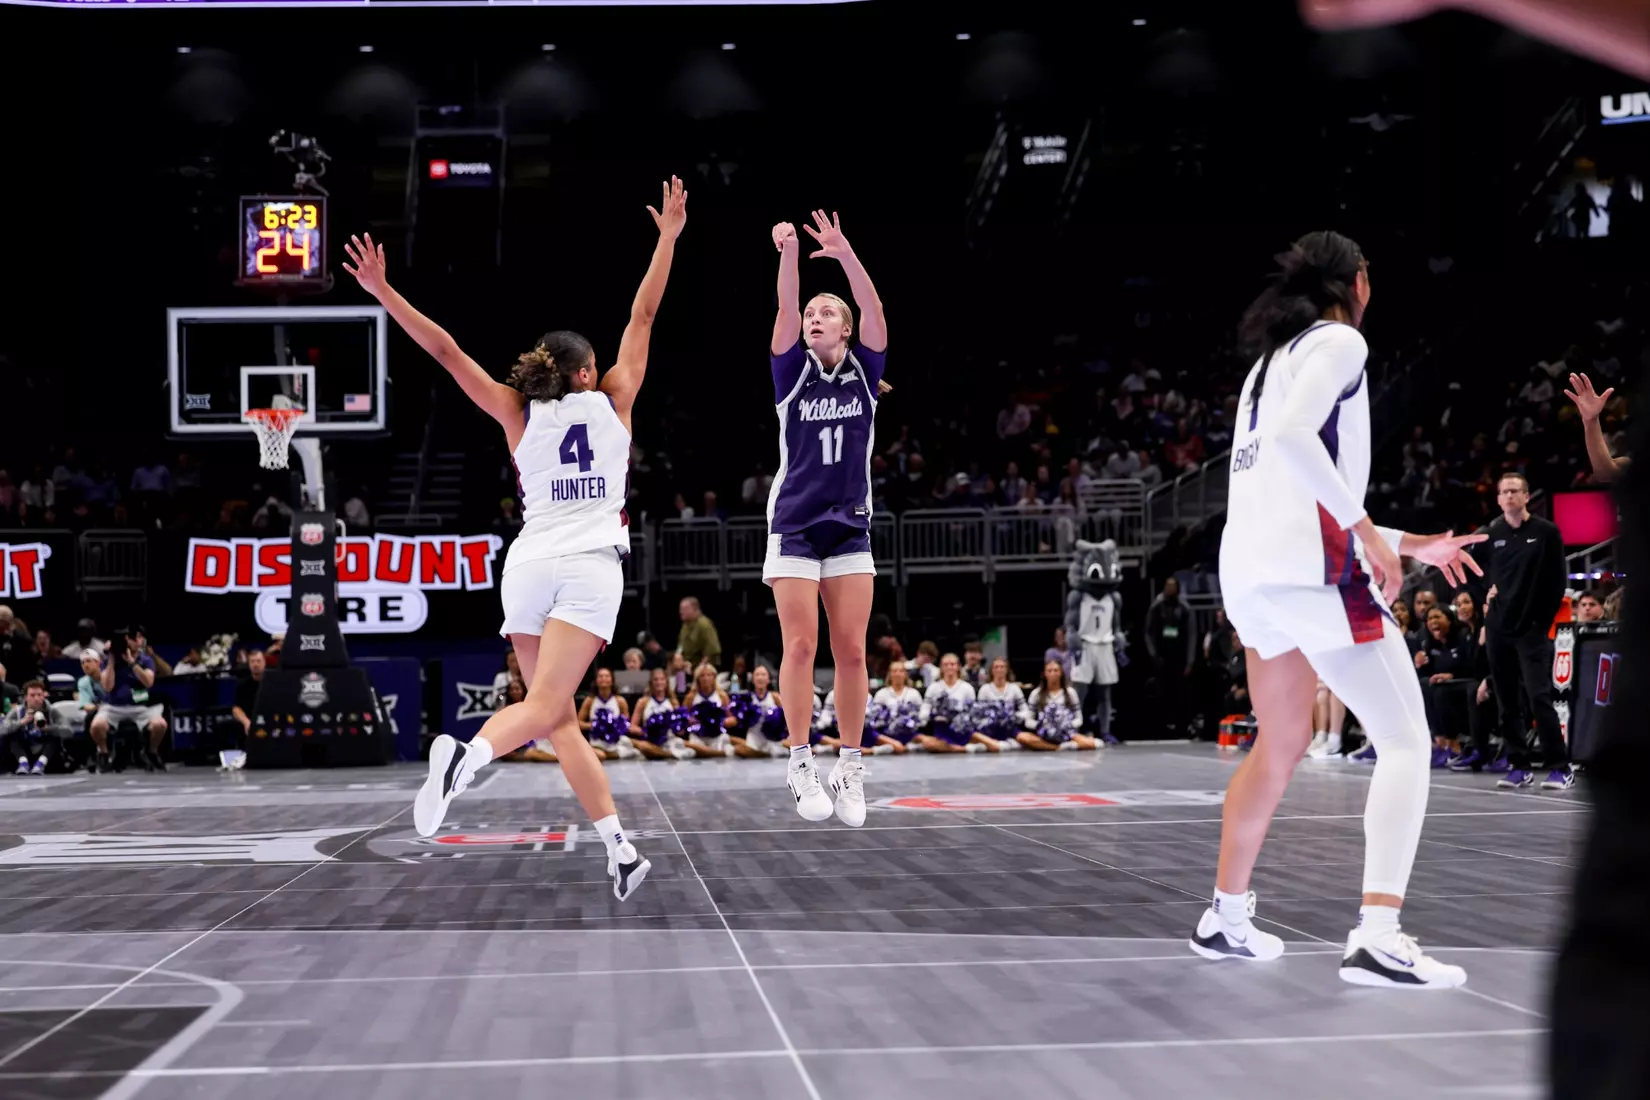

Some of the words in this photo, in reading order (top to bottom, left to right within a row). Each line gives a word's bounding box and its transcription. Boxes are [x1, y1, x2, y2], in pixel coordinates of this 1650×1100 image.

[450, 162, 491, 174] TOYOTA
[264, 205, 317, 230] 6:23
[257, 231, 310, 273] 24
[799, 396, 862, 421] Wildcats
[559, 423, 594, 473] 4
[819, 425, 843, 465] 11
[552, 477, 605, 501] HUNTER
[187, 534, 495, 594] DISOUNT
[276, 597, 405, 622] TRE
